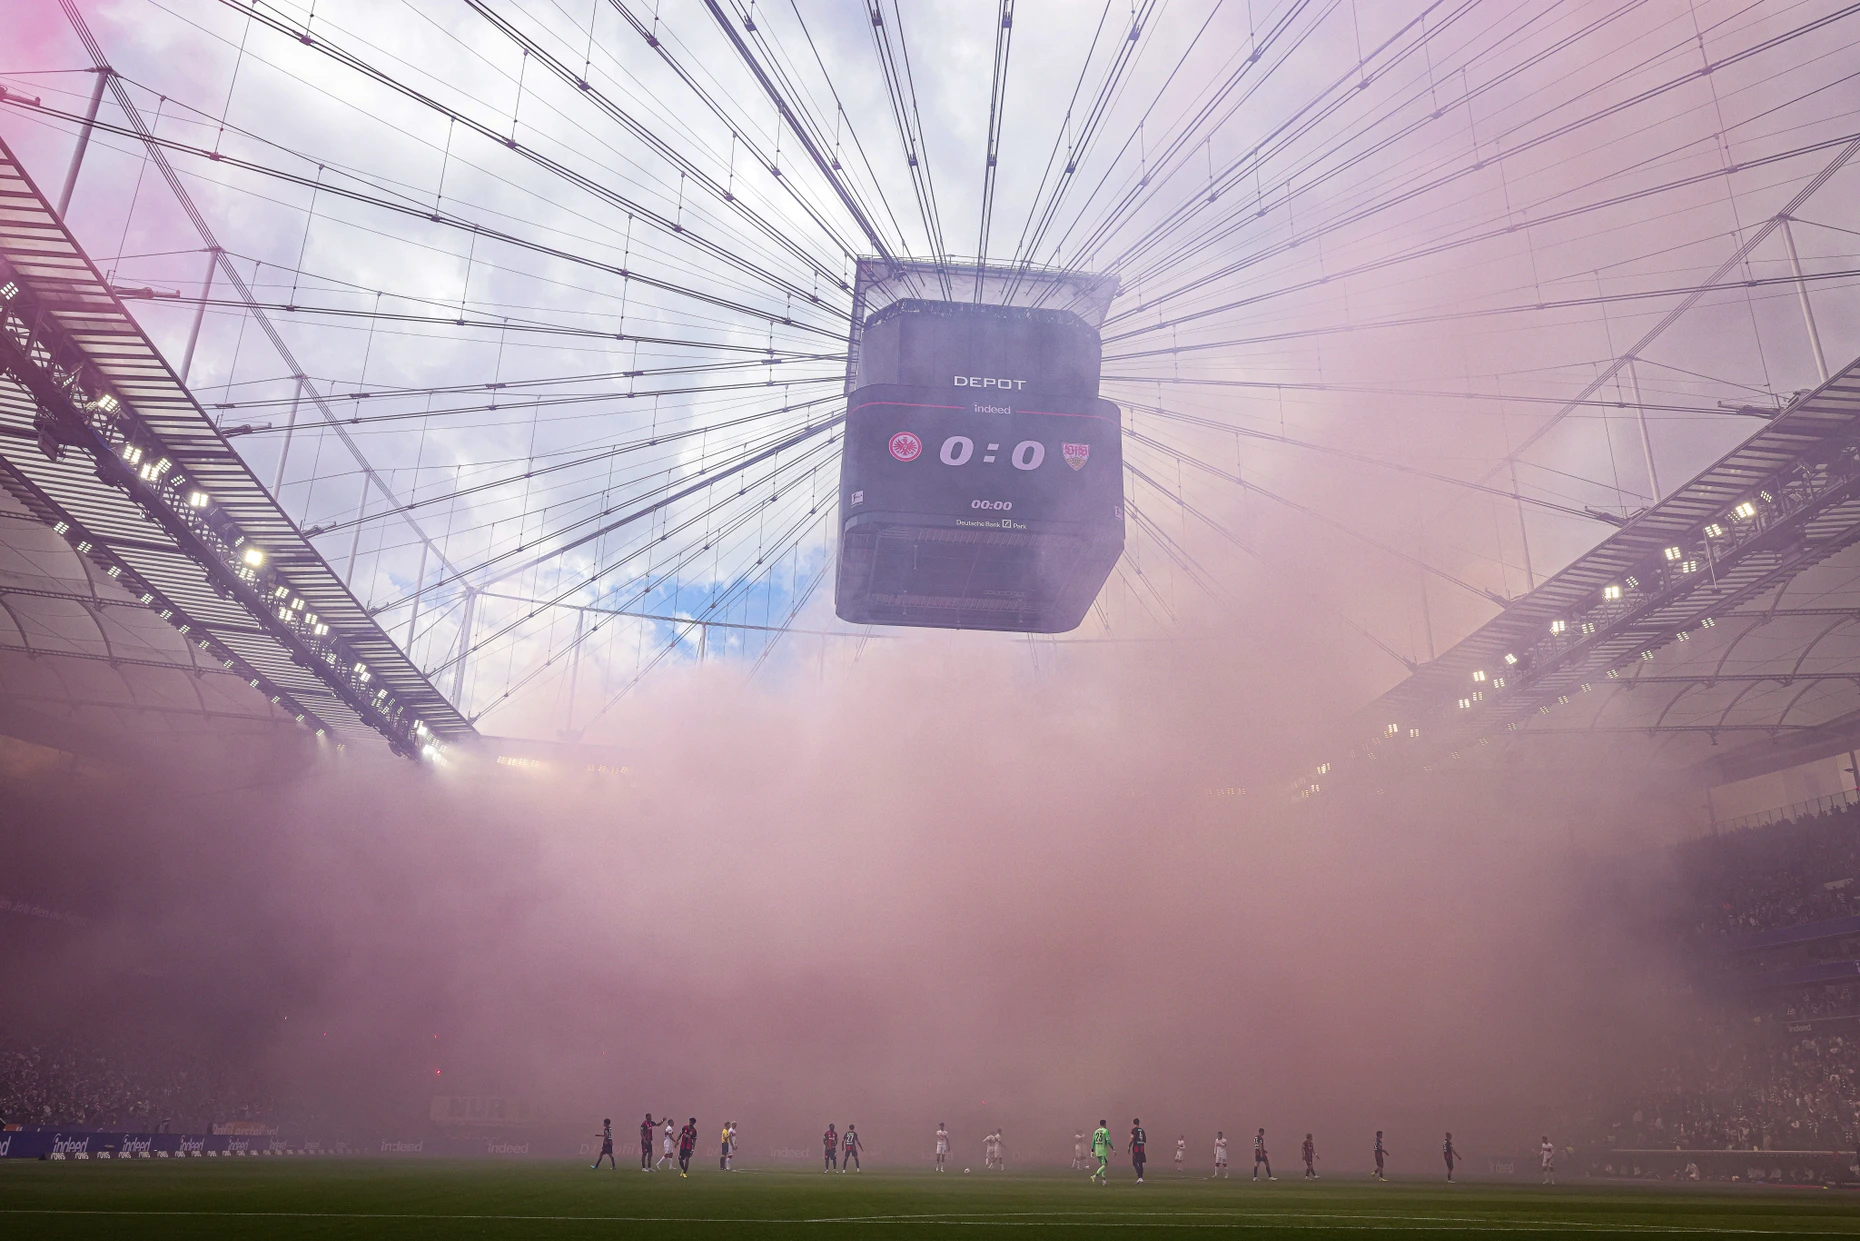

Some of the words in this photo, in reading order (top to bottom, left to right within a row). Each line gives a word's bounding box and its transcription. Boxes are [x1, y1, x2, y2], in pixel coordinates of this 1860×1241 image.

[954, 376, 1027, 390] DEPOT
[973, 403, 1011, 415] indeed
[971, 499, 1013, 511] 00:00
[1013, 522, 1027, 530] Park
[52, 1133, 89, 1152] indeed
[122, 1134, 151, 1152] indeed
[1096, 1132, 1103, 1143] 23
[381, 1139, 423, 1152] indeed
[487, 1141, 528, 1154] indeed
[769, 1147, 809, 1159] indeed
